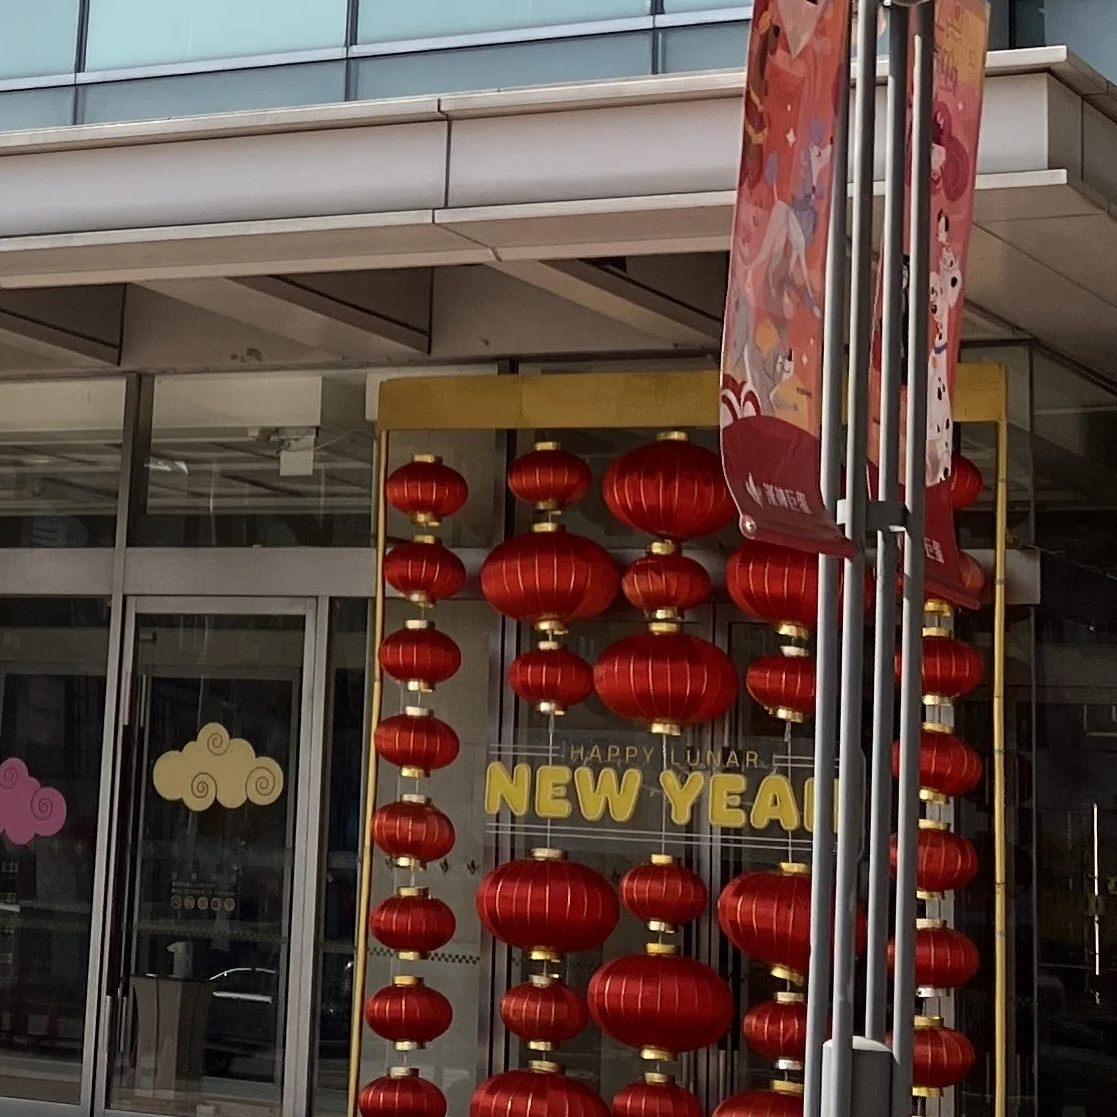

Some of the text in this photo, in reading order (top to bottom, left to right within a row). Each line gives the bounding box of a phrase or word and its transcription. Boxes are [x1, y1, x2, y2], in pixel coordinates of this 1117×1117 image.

[569, 744, 760, 769] HAPPY LUNAR
[484, 761, 642, 823] NEW
